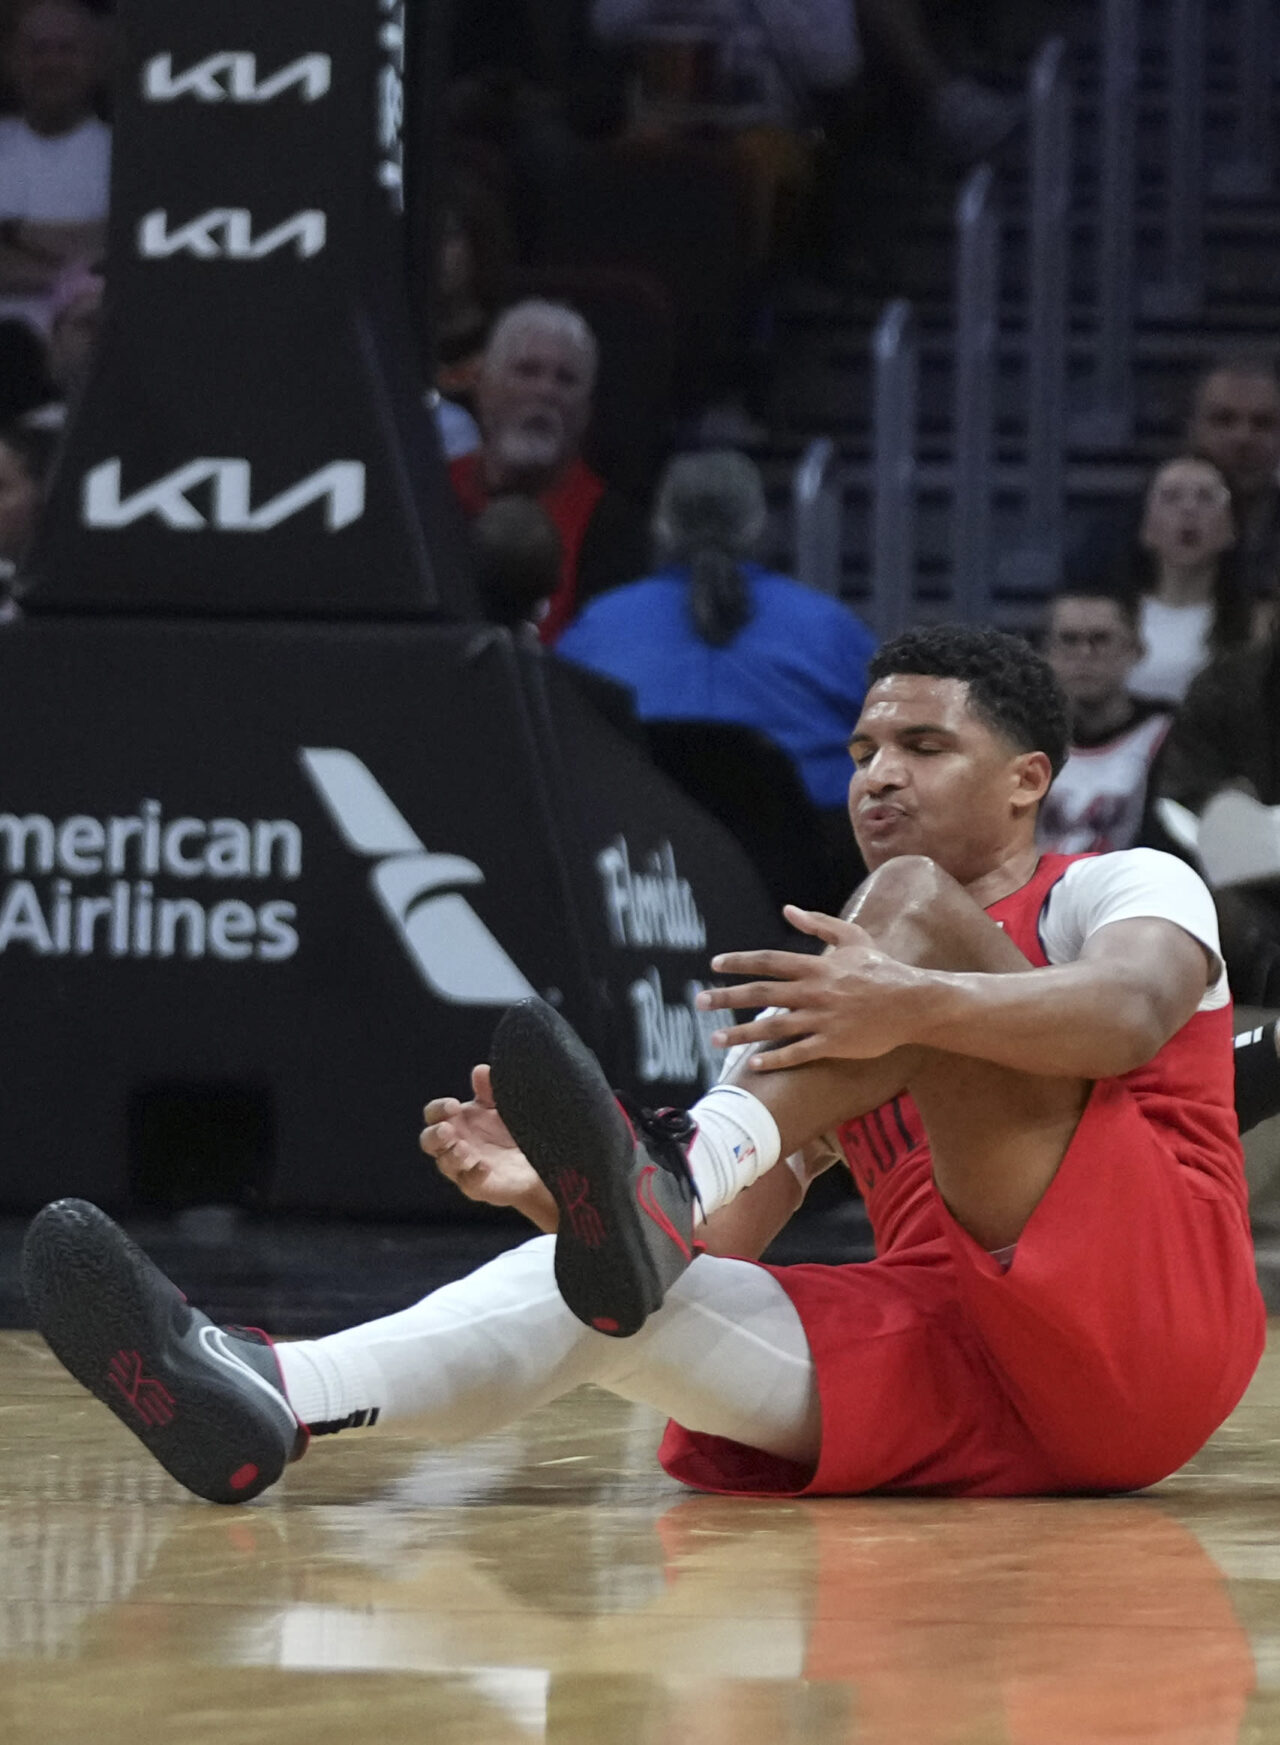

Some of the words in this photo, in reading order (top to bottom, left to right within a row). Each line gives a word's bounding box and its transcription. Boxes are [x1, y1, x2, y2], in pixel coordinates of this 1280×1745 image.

[144, 50, 332, 102] KIA
[139, 208, 327, 259] KIA
[83, 456, 366, 532] KIA
[0, 879, 299, 959] Airlines
